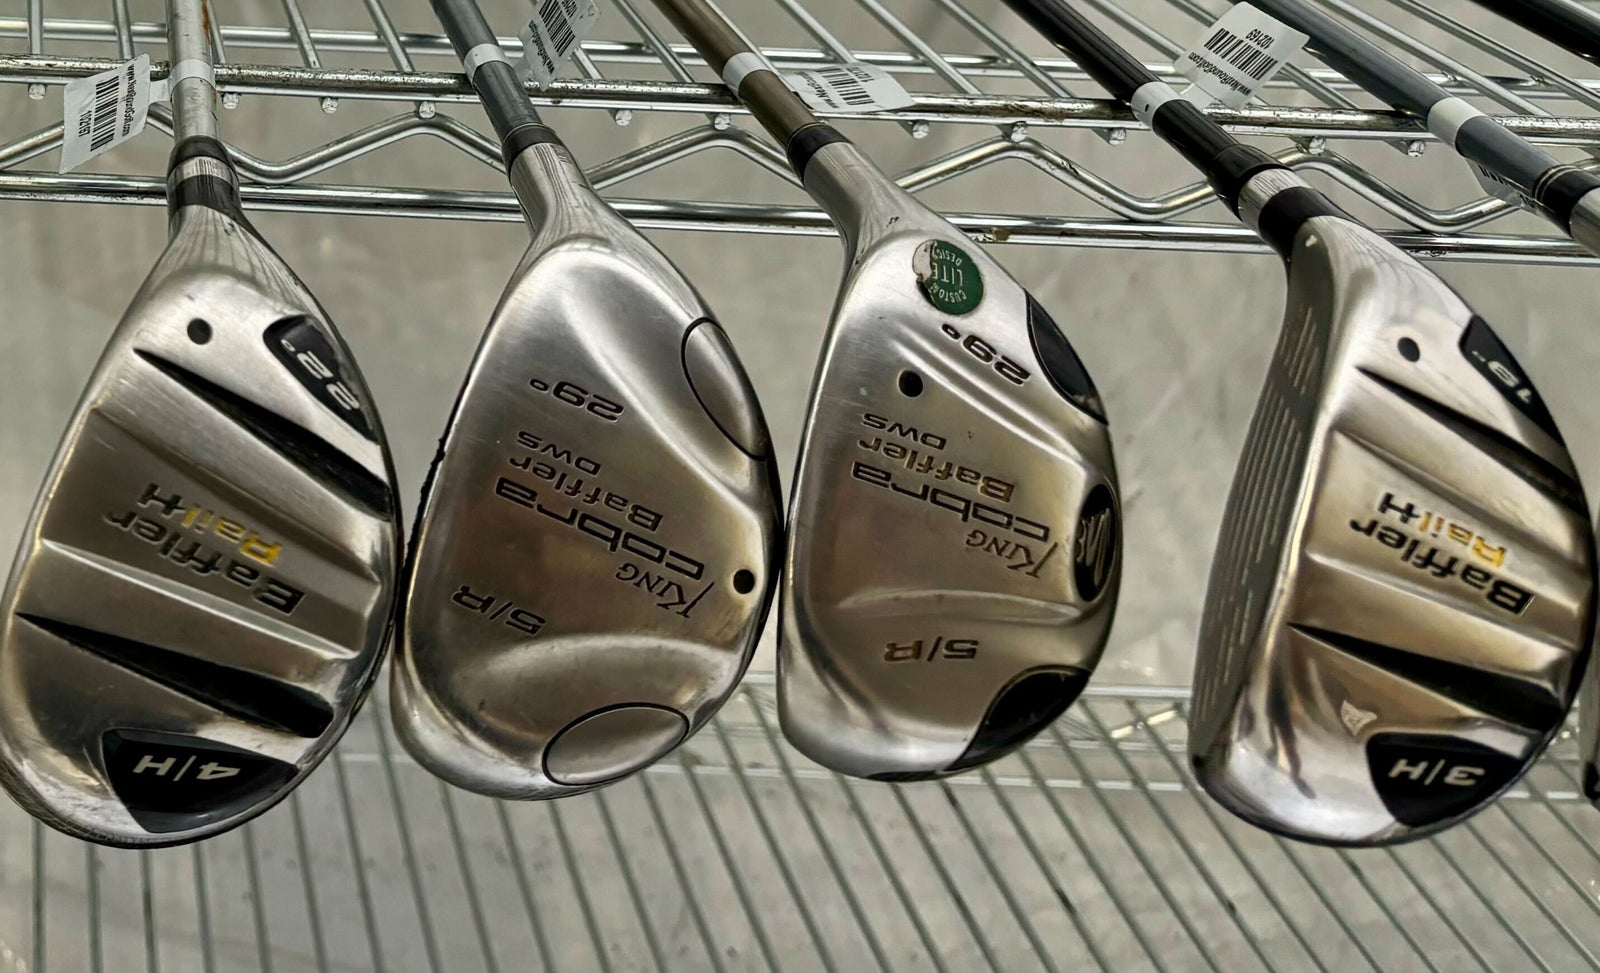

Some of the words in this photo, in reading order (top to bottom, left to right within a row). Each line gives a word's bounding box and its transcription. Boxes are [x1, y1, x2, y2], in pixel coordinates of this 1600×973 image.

[1245, 28, 1274, 50] 102169
[931, 262, 963, 286] LITE
[517, 430, 601, 476] DWS
[862, 412, 947, 451] DWS
[859, 436, 1015, 503] Baffler
[509, 456, 662, 532] Baffler
[102, 509, 306, 615] Baffler
[1350, 519, 1536, 615] Baffler
[452, 585, 546, 636] 5/R
[884, 636, 980, 662] 5/R
